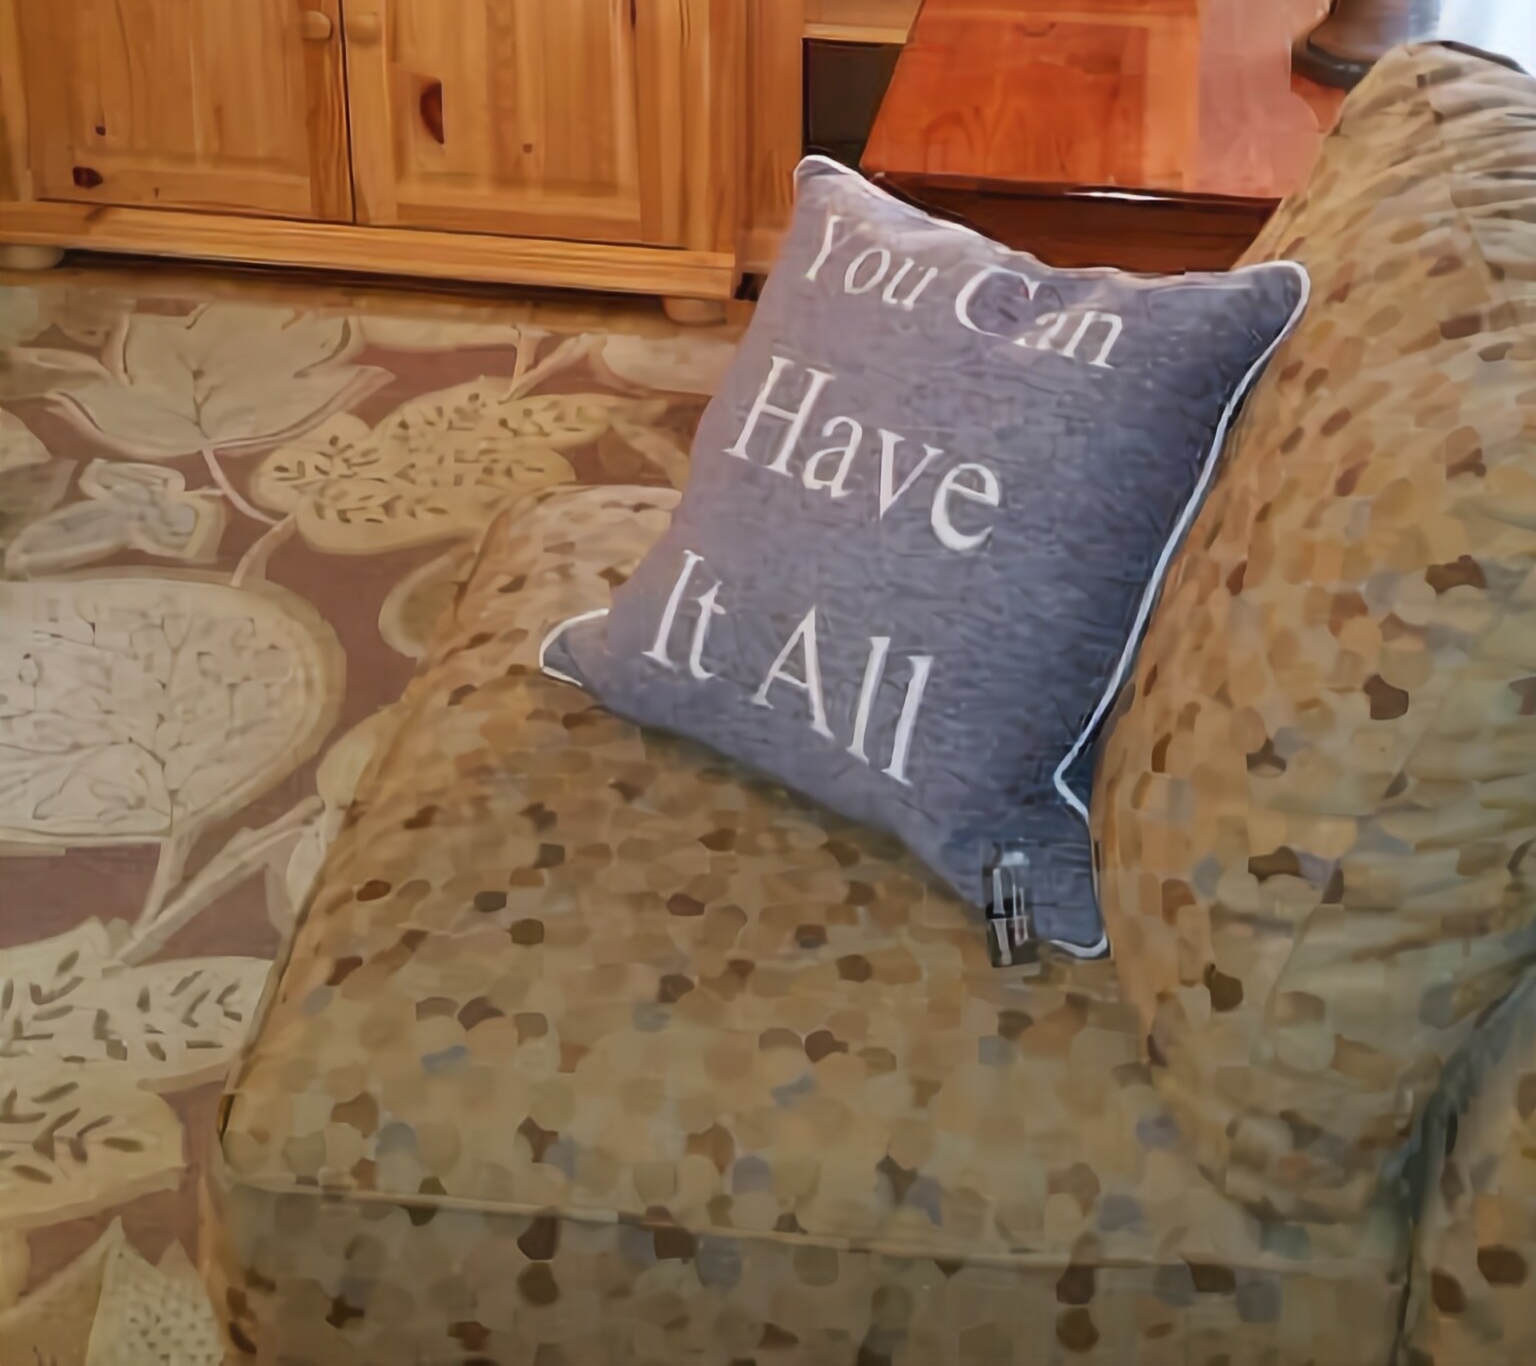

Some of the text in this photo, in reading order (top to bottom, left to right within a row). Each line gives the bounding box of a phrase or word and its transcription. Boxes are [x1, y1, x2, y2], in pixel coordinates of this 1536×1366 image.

[806, 214, 1124, 369] You Can
[723, 355, 1000, 552] Have
[641, 548, 935, 786] It All
